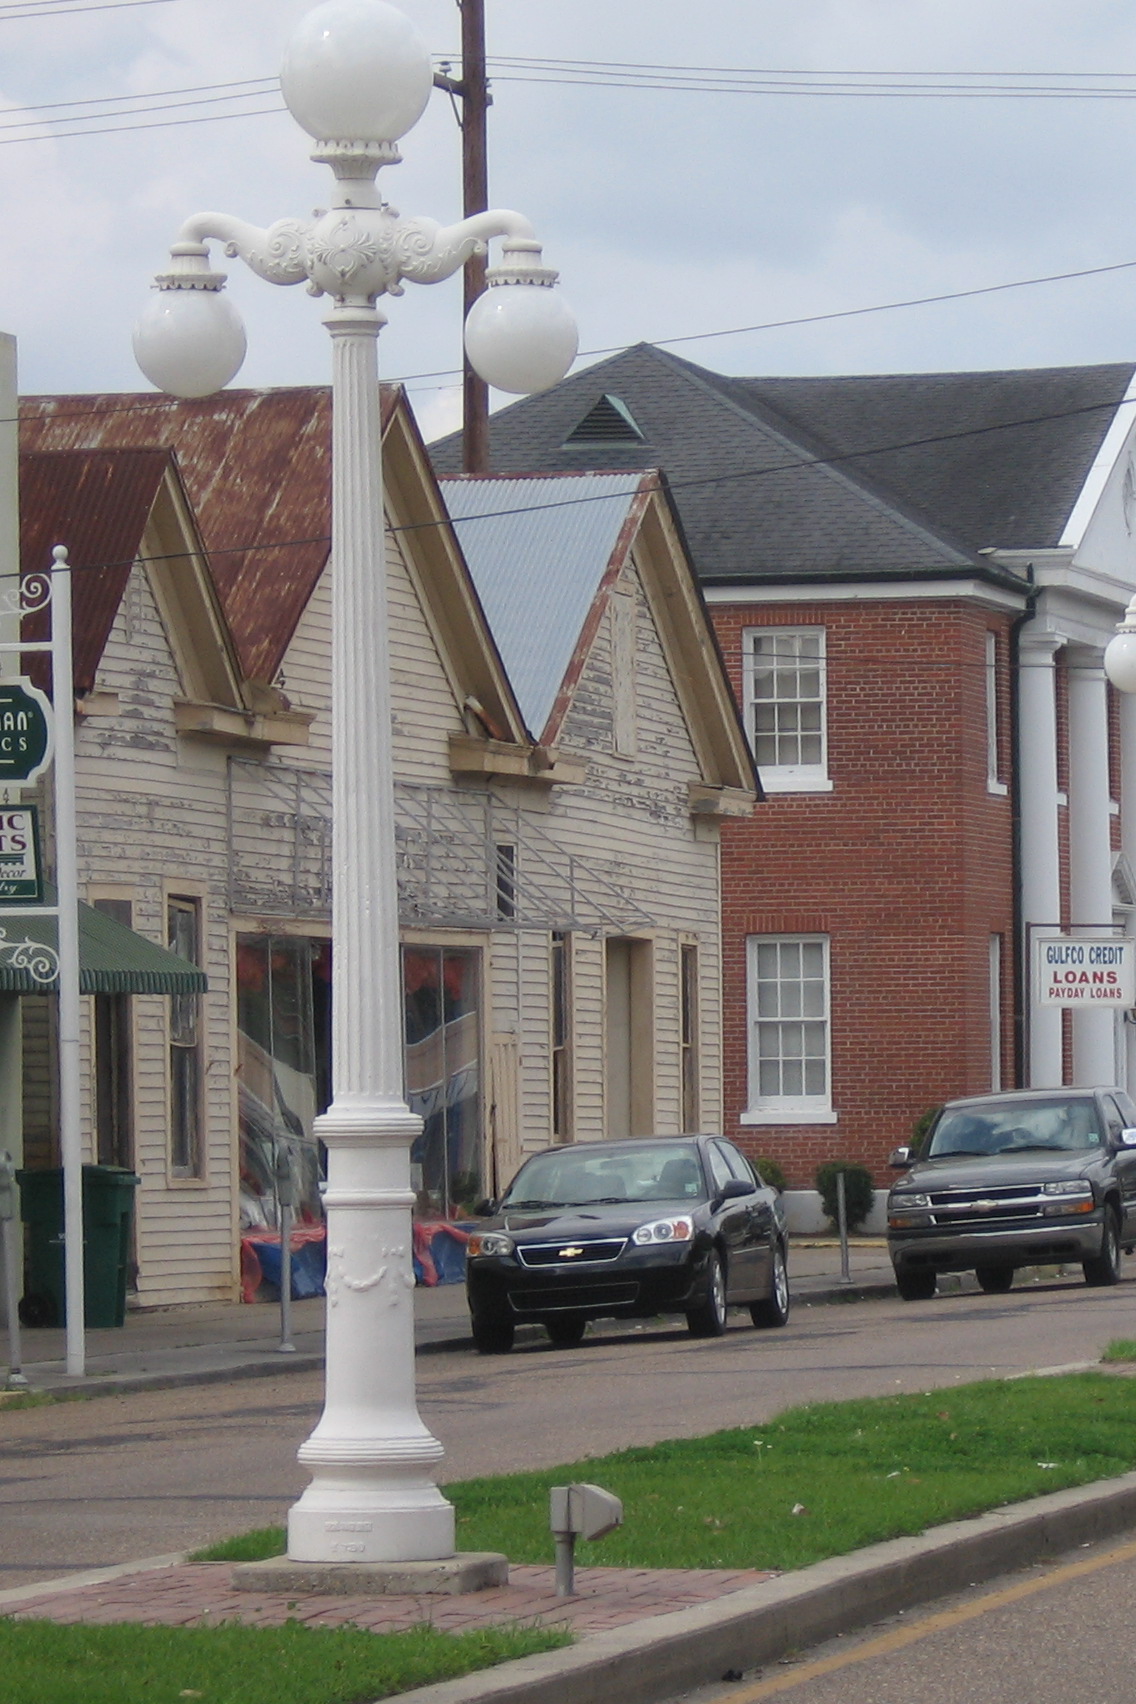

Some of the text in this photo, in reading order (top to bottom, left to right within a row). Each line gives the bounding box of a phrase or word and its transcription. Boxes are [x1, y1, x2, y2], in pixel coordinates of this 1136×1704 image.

[0, 711, 28, 731] AN
[1, 737, 28, 751] CS
[0, 813, 25, 831] IC
[0, 834, 27, 852] TS
[1047, 946, 1124, 964] GULFCO CREDIT
[1053, 971, 1118, 984] LOANS
[1049, 987, 1122, 998] PAYDAY LOANS
